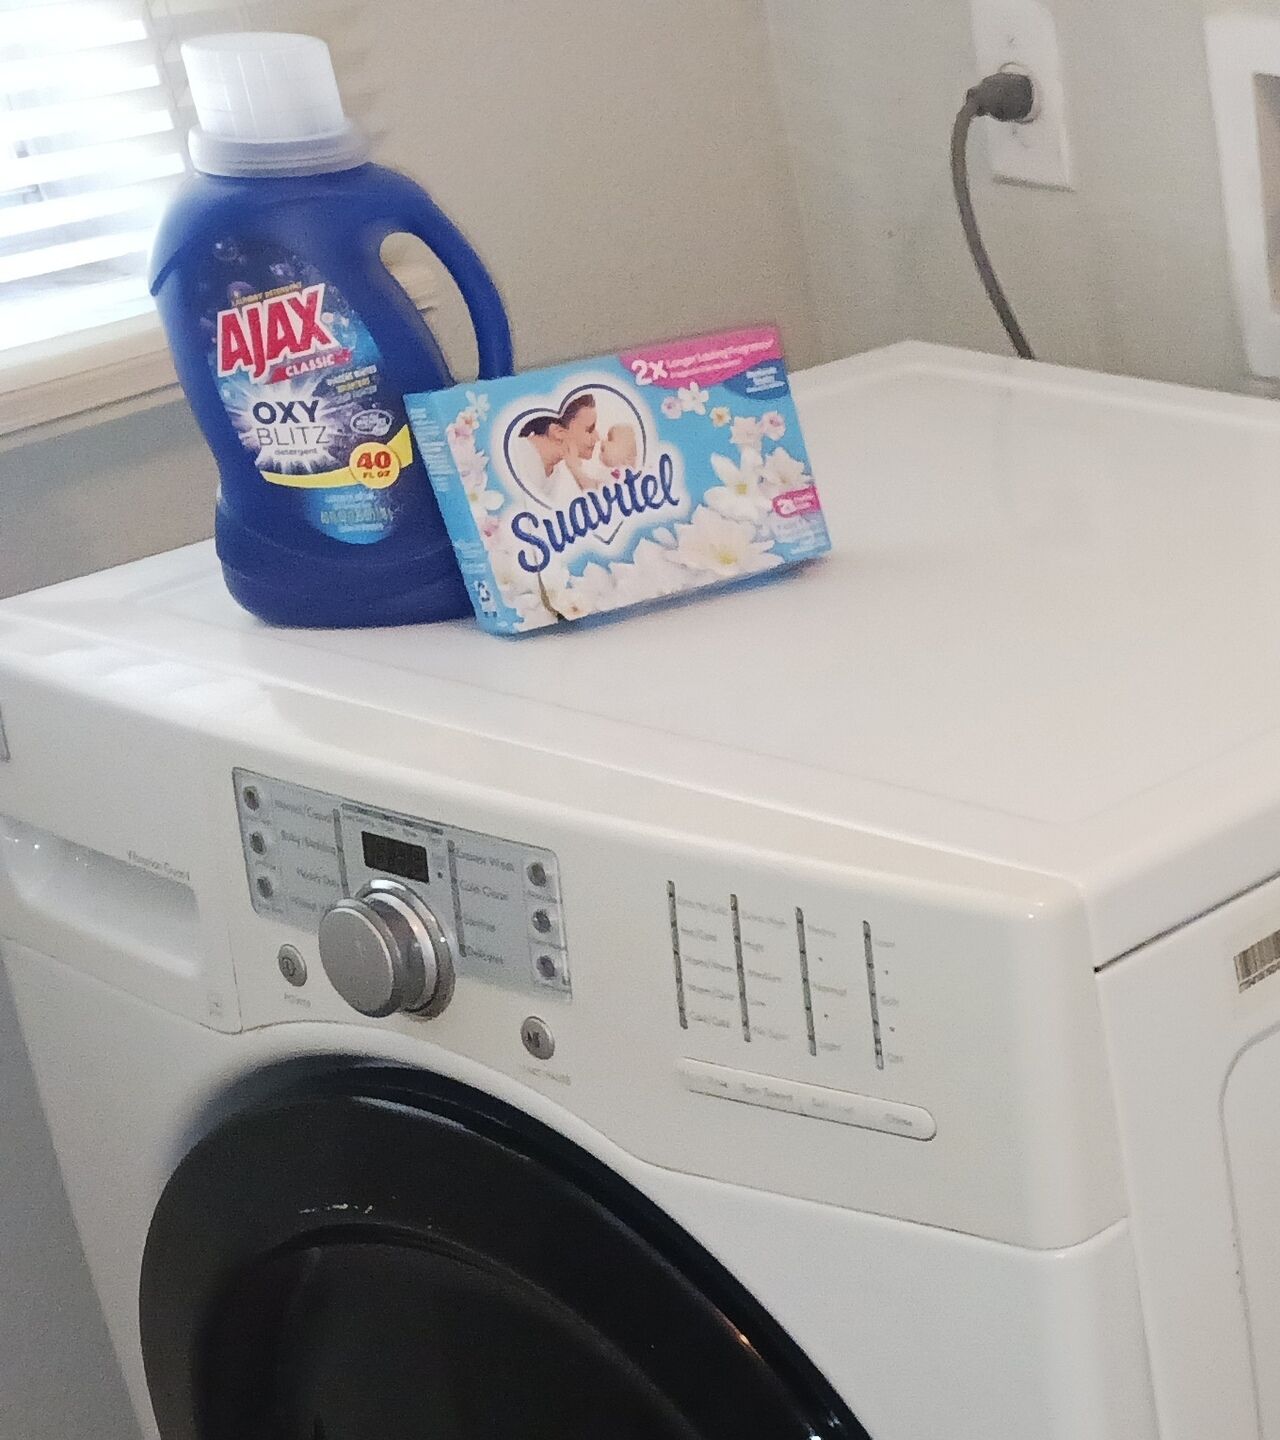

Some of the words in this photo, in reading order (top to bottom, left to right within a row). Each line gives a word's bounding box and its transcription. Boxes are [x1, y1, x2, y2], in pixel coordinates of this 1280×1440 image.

[219, 286, 339, 381] AJAX
[285, 353, 335, 377] CLASSIC
[252, 400, 320, 425] OXY
[256, 426, 331, 447] BLITZ
[356, 451, 392, 470] 40
[511, 453, 680, 574] Suavitel
